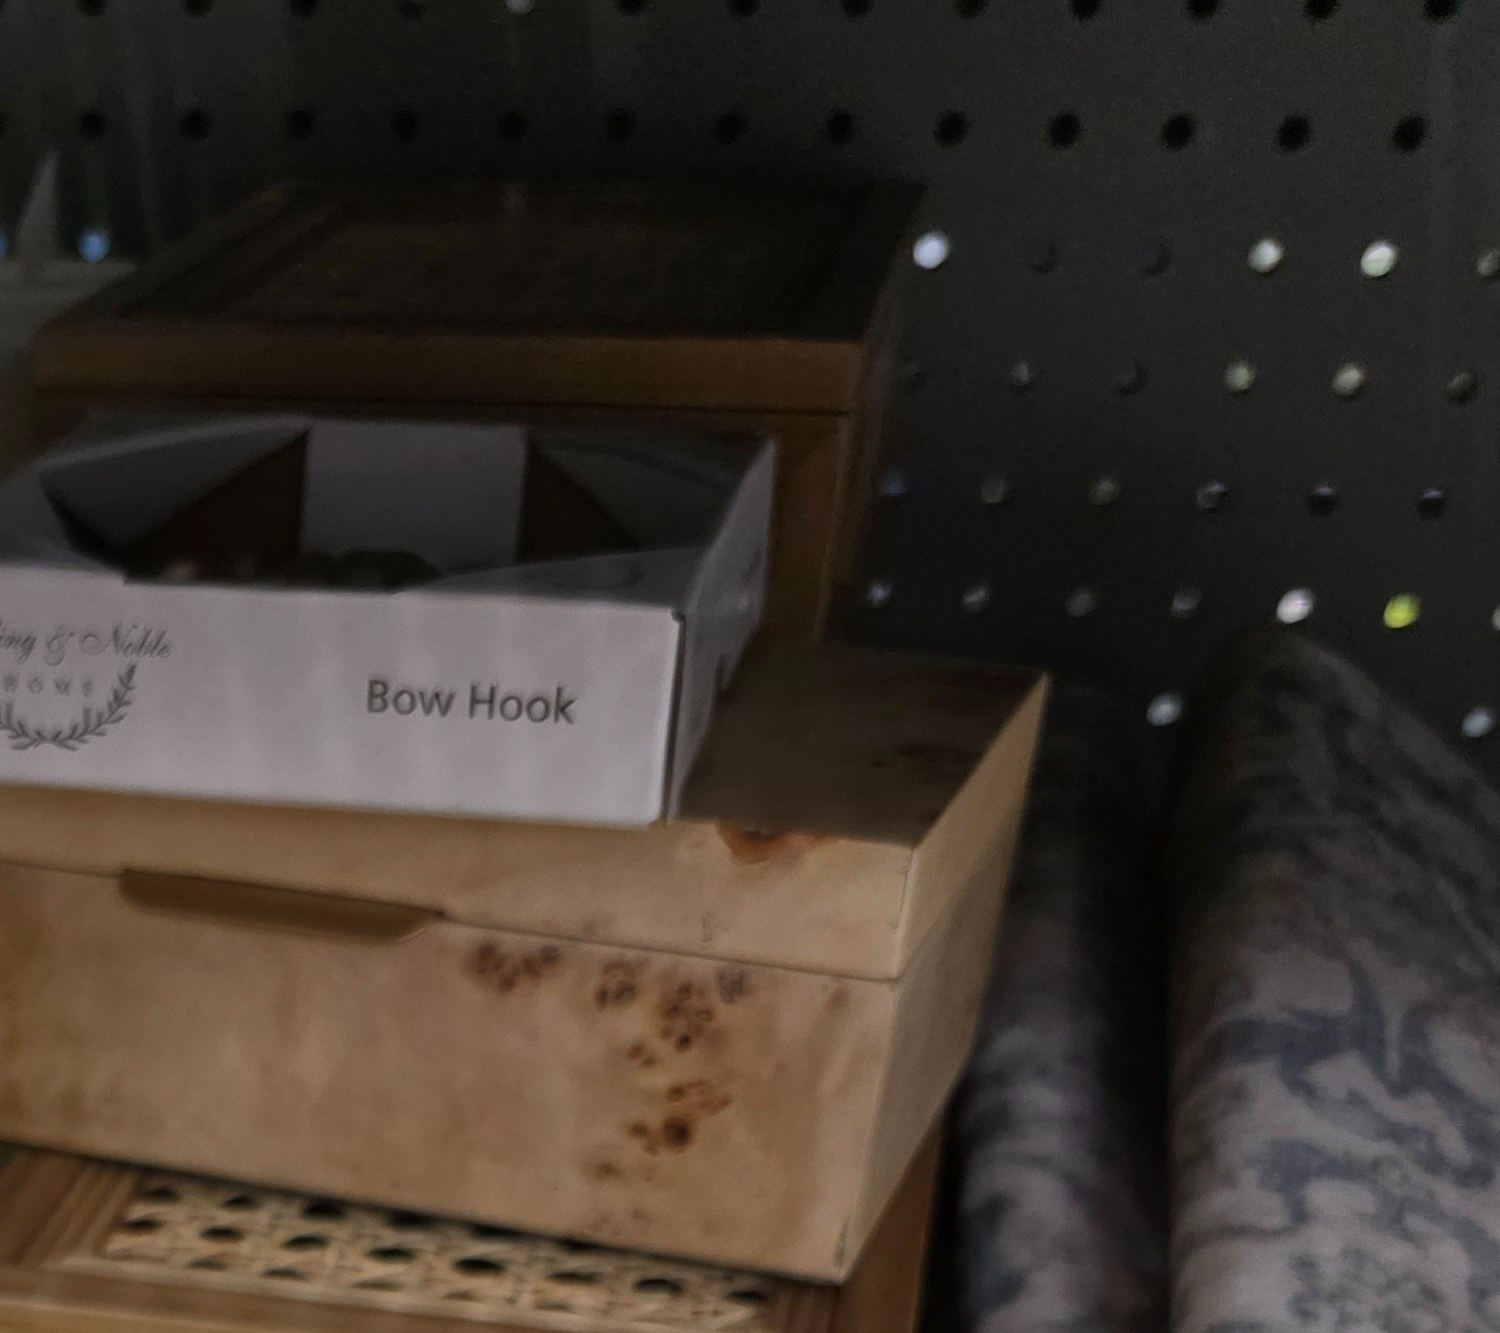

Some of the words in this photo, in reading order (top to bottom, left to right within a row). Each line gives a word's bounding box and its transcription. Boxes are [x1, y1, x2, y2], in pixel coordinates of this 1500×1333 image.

[78, 621, 175, 658] Noble
[366, 679, 456, 718] Bow
[468, 684, 579, 726] Hook
